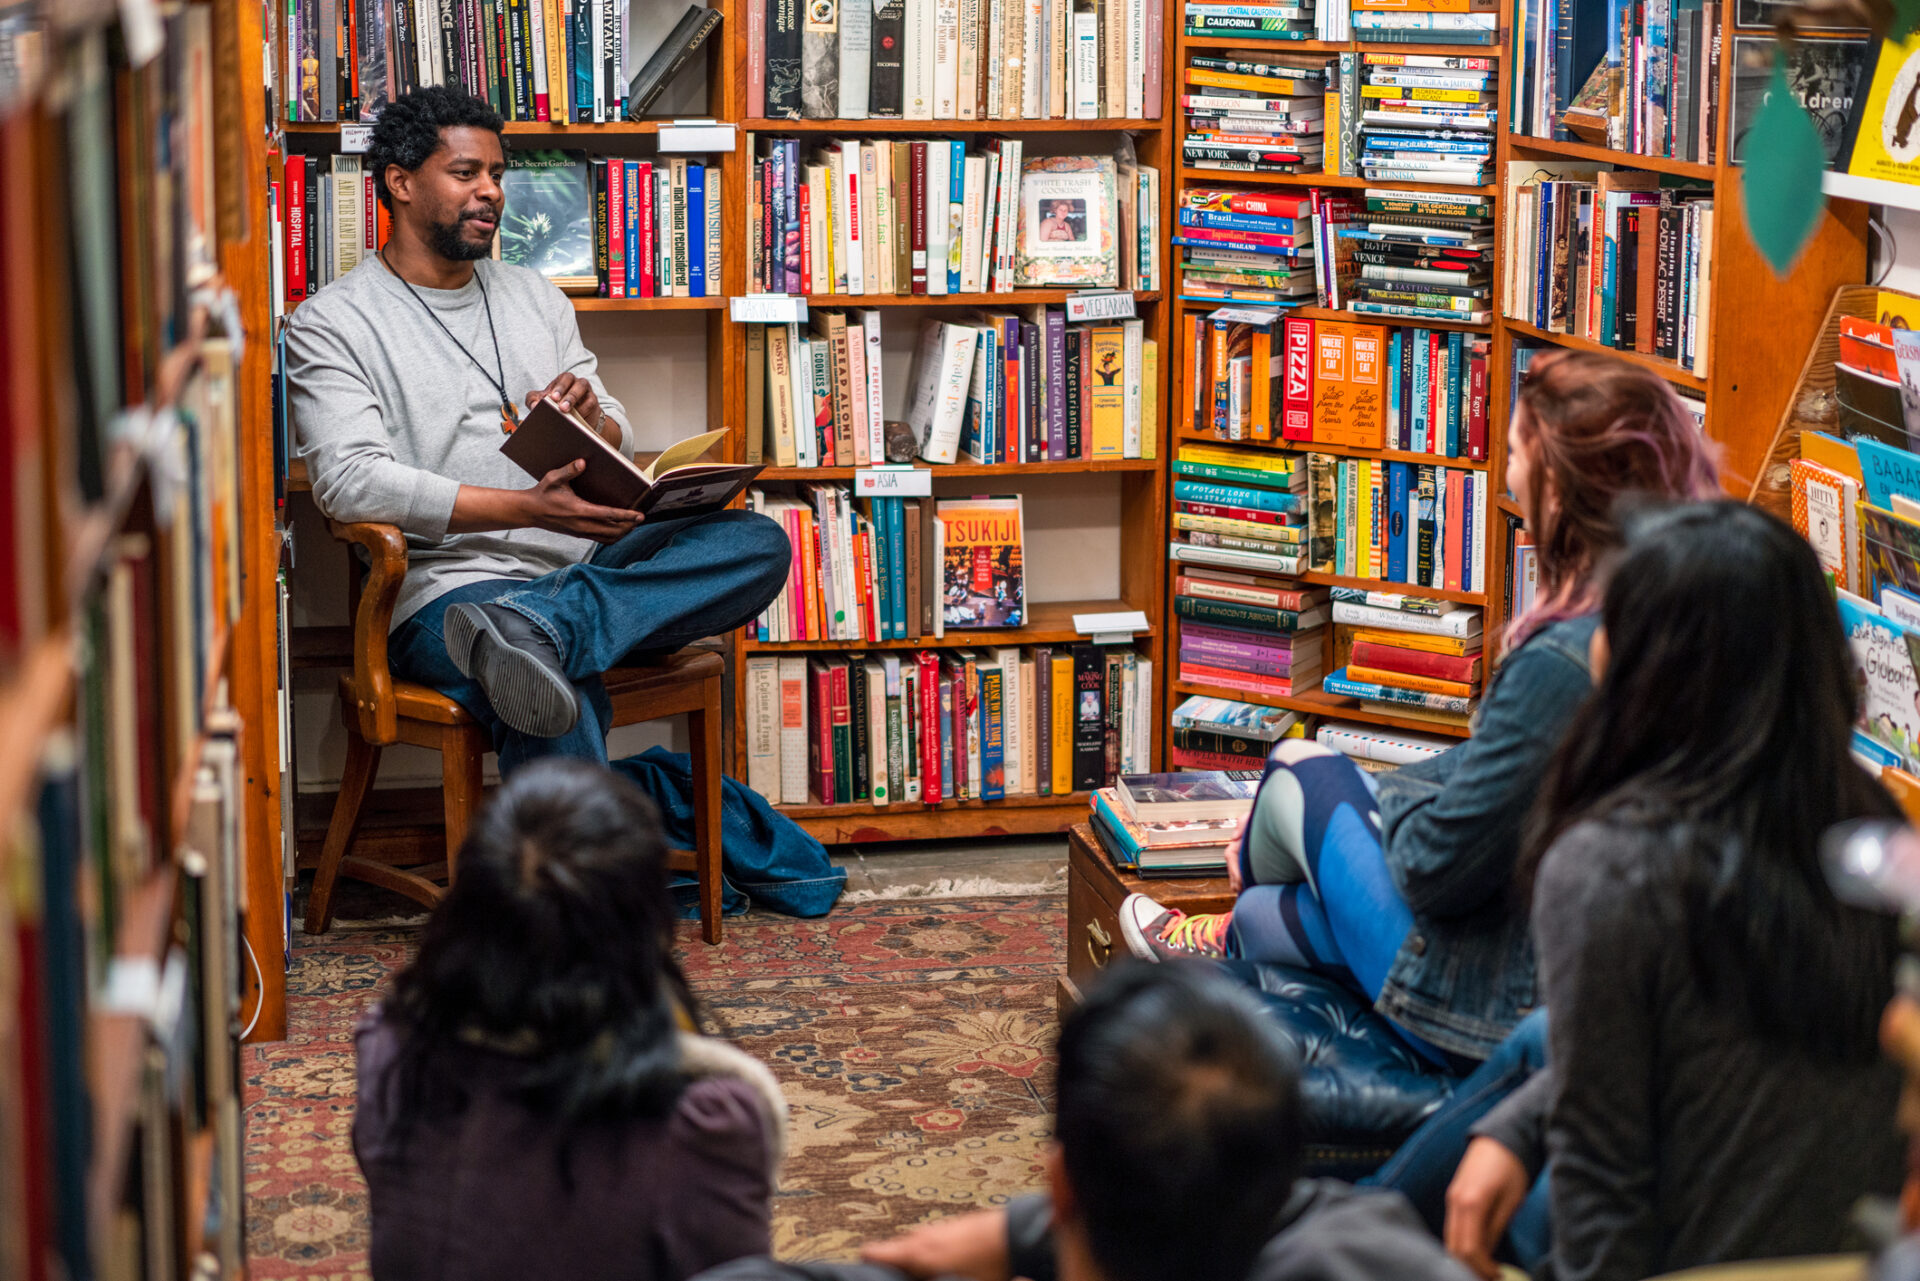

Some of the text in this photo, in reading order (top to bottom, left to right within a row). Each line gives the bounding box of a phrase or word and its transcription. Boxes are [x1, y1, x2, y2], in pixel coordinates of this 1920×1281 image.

[1207, 17, 1256, 28] CALIFORNIA
[1203, 97, 1240, 108] OREGON
[1763, 91, 1853, 109] ldren
[1185, 148, 1230, 160] NEW YORK
[510, 160, 576, 168] The Secret Garden
[1219, 160, 1251, 170] ARIZONA
[1381, 170, 1415, 180] TUNISIA
[611, 167, 623, 239] cannabinomics
[1245, 201, 1268, 212] CHINA
[709, 200, 720, 249] INVISIBLE
[1208, 213, 1232, 222] Brazil
[290, 207, 302, 248] HOSPITAL
[674, 187, 688, 286] marihuana reconsidered
[1363, 241, 1393, 252] EGYPT
[1667, 230, 1677, 277] sleeping
[709, 251, 720, 281] HAND
[1354, 252, 1386, 264] VENICE
[1657, 218, 1669, 323] CADILLAC DESERT
[1395, 284, 1431, 293] SASTUN
[1321, 338, 1342, 348] WHERE
[1666, 327, 1674, 346] fall
[1322, 348, 1341, 359] CHEFS
[1355, 341, 1376, 351] WHERE
[1290, 334, 1306, 395] PIZZA
[1326, 359, 1337, 369] EAT
[1356, 352, 1375, 362] CHEFS
[814, 353, 825, 387] COOKIES
[1052, 350, 1062, 386] HEART
[1359, 362, 1370, 373] EAT
[1421, 365, 1430, 393] MADOX
[836, 338, 852, 441] BREAD ALONE
[872, 366, 881, 444] PERFECT FINISH
[1067, 356, 1080, 446] Vegetarianism
[1421, 395, 1429, 416] FORD
[1472, 396, 1482, 418] Egypt
[1053, 408, 1062, 441] PLATE
[877, 473, 898, 488] ASIA
[1811, 487, 1834, 504] HITTY
[944, 519, 1017, 543] TSUKIJI
[1197, 605, 1208, 613] THE
